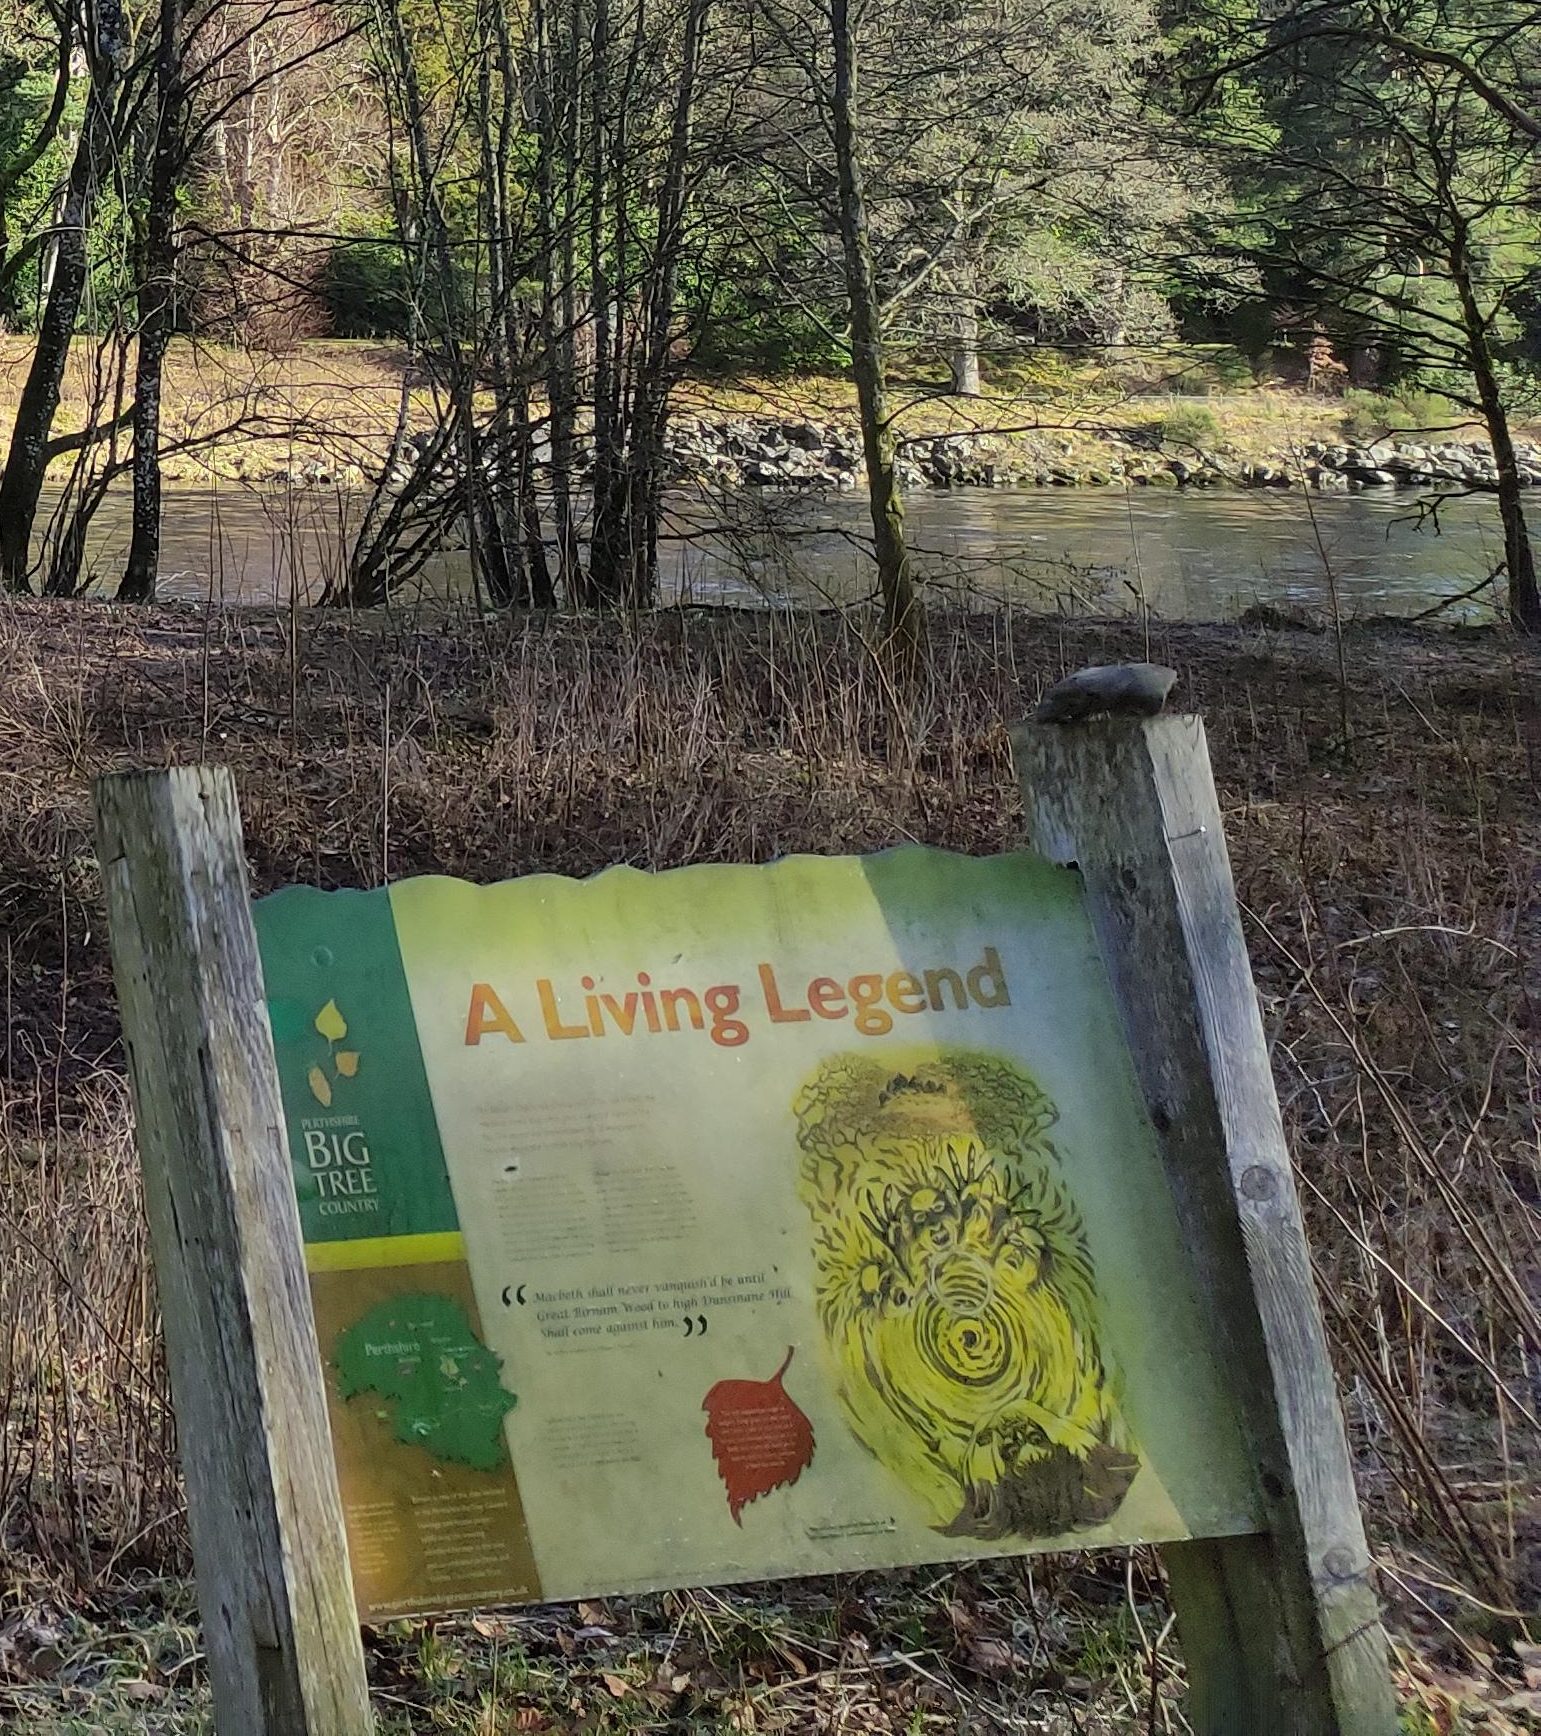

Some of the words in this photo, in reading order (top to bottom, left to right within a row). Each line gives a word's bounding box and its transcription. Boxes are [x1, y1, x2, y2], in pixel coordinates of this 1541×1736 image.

[465, 983, 526, 1046] A
[536, 971, 749, 1047] Living
[758, 946, 1012, 1036] Legend
[304, 1130, 370, 1168] BIG
[311, 1168, 377, 1197] TREE
[319, 1198, 379, 1216] COUNTRY
[533, 1288, 583, 1303] Macbeth
[588, 1285, 613, 1298] shall
[618, 1284, 650, 1295] never
[721, 1275, 734, 1288] be
[737, 1272, 765, 1285] until
[536, 1310, 568, 1323] Great
[573, 1306, 617, 1319] Birnam
[621, 1301, 654, 1313] Wood
[658, 1299, 669, 1311] to
[673, 1297, 698, 1312] high
[573, 1325, 602, 1337] come
[606, 1319, 649, 1337] against
[365, 1340, 421, 1357] Perthshire
